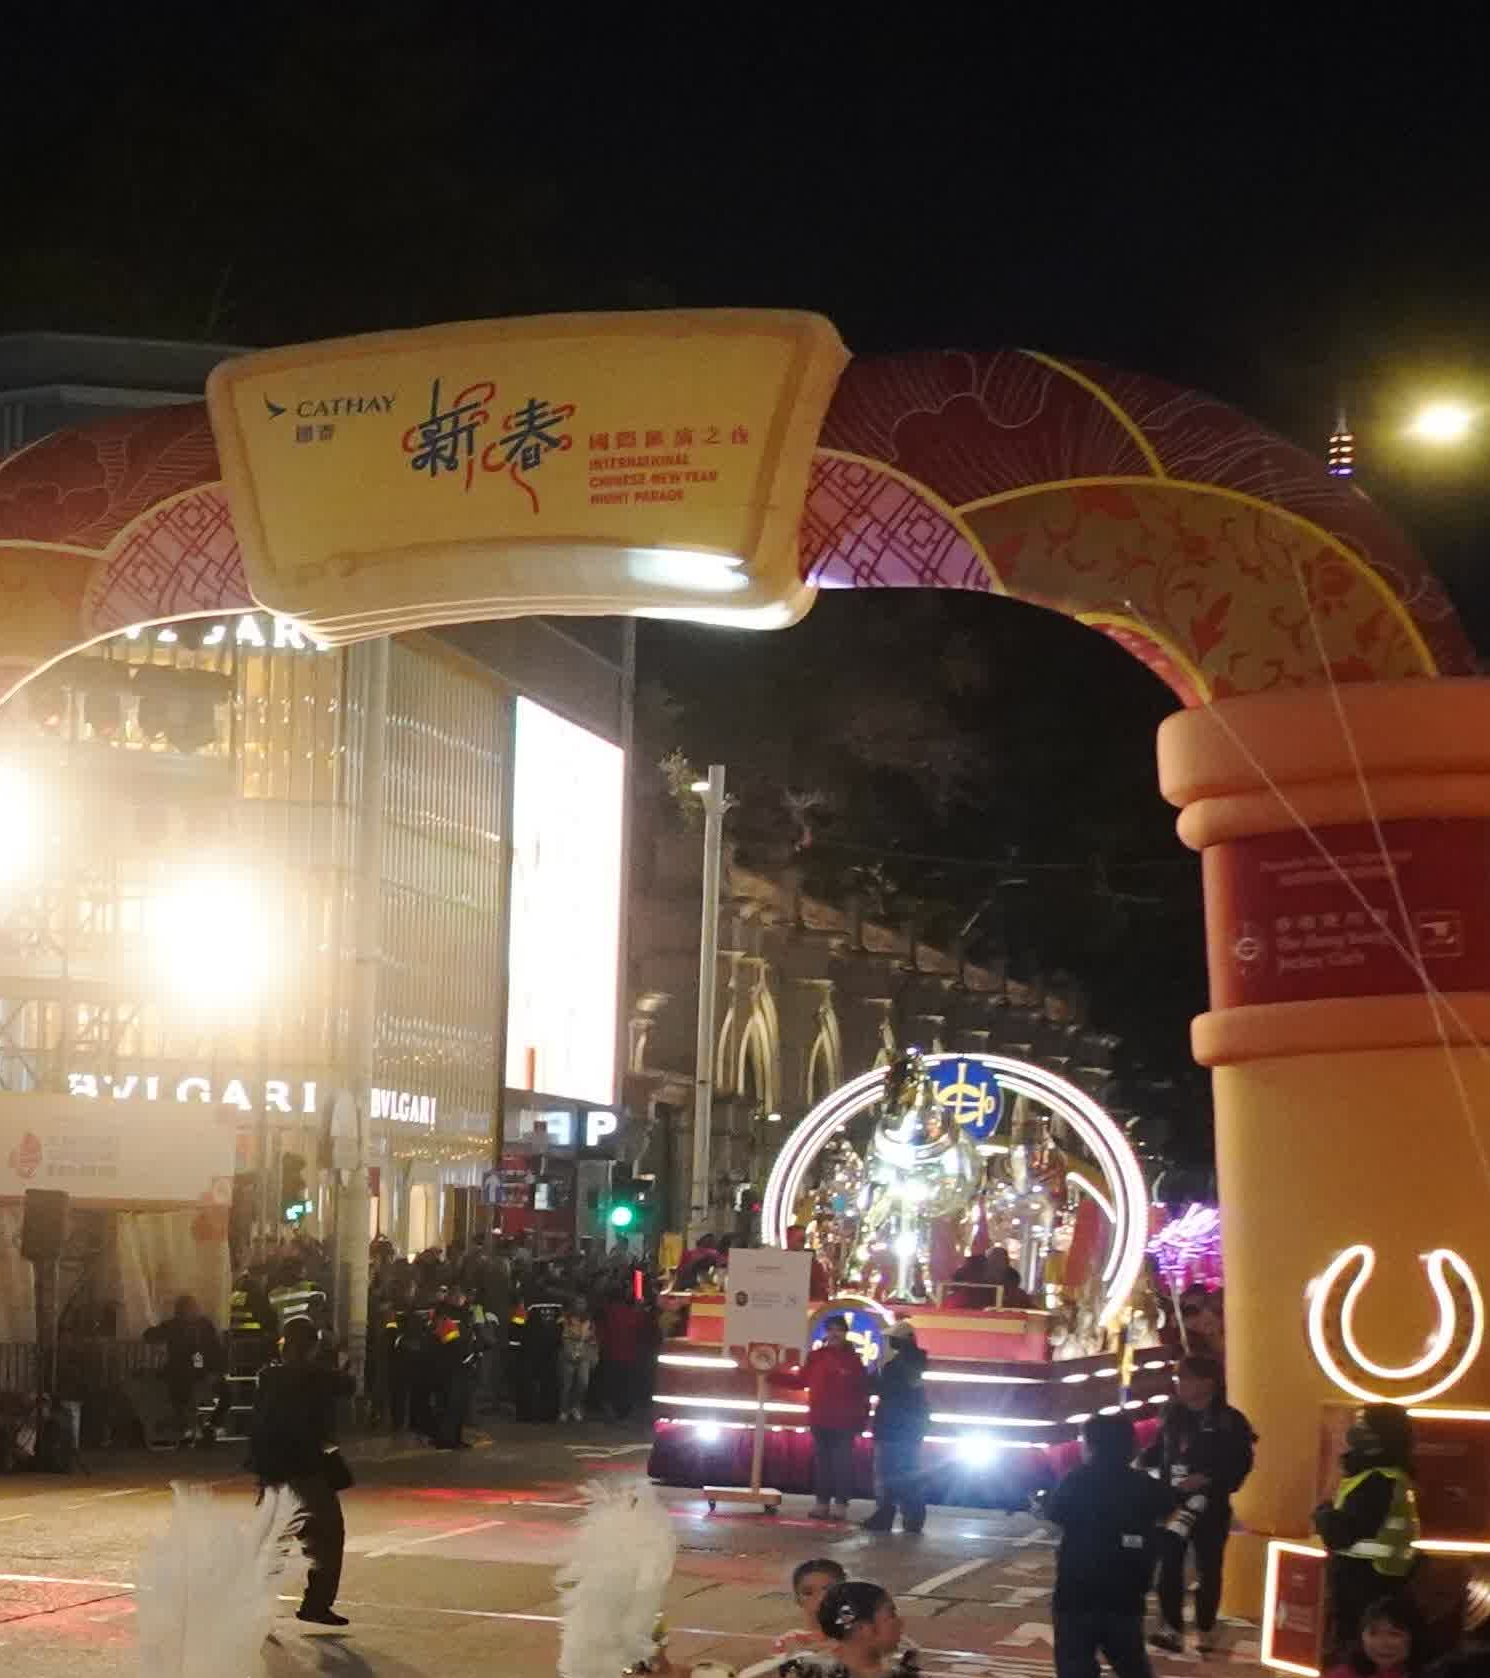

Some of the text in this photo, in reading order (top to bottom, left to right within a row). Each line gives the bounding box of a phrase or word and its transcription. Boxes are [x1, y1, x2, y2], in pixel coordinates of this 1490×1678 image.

[296, 392, 396, 418] CATHAY
[405, 378, 574, 497] 新春
[589, 454, 690, 470] INTERNATIONAL
[589, 470, 719, 488] CHINESE NEW YEAR
[590, 489, 685, 505] NIGHT PARADE
[67, 1072, 317, 1113] BVLGARI
[369, 1087, 437, 1126] BVLGARI
